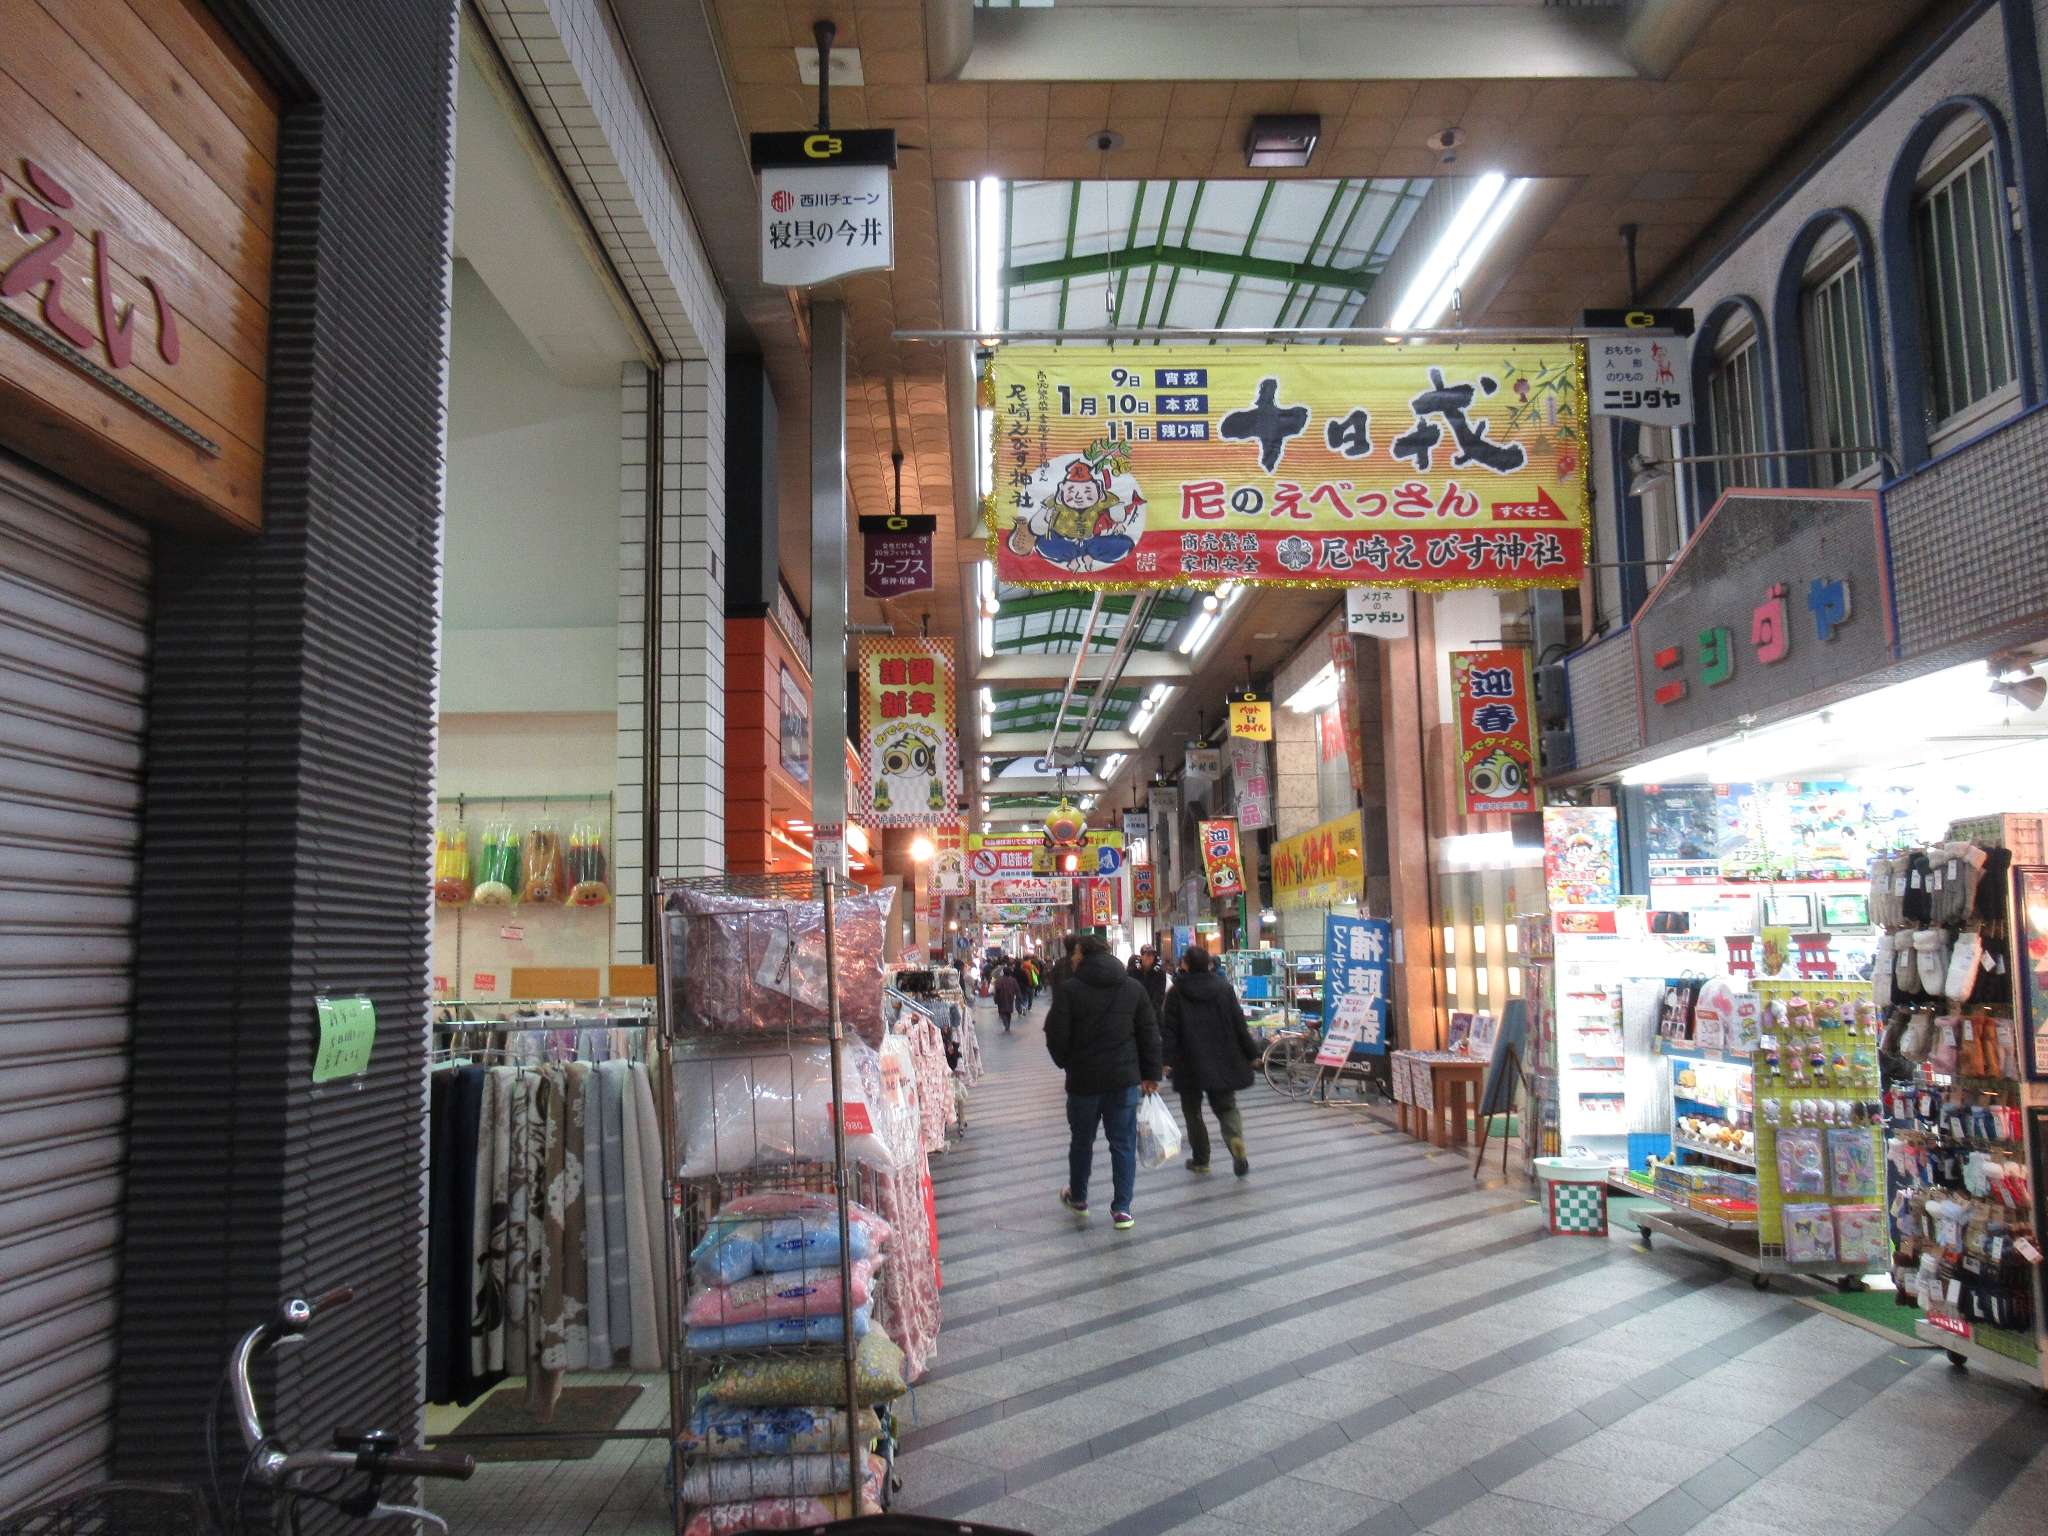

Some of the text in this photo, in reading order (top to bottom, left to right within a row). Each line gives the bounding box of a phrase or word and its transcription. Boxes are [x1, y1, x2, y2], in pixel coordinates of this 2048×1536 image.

[800, 193, 879, 207] 西川チェーン
[770, 218, 882, 249] 寝具の今井
[1605, 346, 1641, 355] おもちゃ
[1112, 369, 1140, 387] 9日
[1057, 385, 1200, 415] 1月 10日 本戎
[1604, 387, 1680, 408] ニシダヤ
[1221, 368, 1526, 473] 十日戎
[1108, 422, 1204, 440] 11日 残り福
[1181, 481, 1479, 519] 尼のえべっさん
[1500, 505, 1550, 518] すぐそこ
[1181, 534, 1258, 552] 商売繁盛
[1318, 534, 1565, 571] 尼崎えびす神社
[869, 558, 926, 575] カーブス
[1181, 555, 1258, 574] 家内安全
[1361, 592, 1392, 601] メガネ
[1373, 602, 1382, 610] の
[1655, 577, 1850, 704] ニシダヤ
[1471, 669, 1515, 732] 迎春
